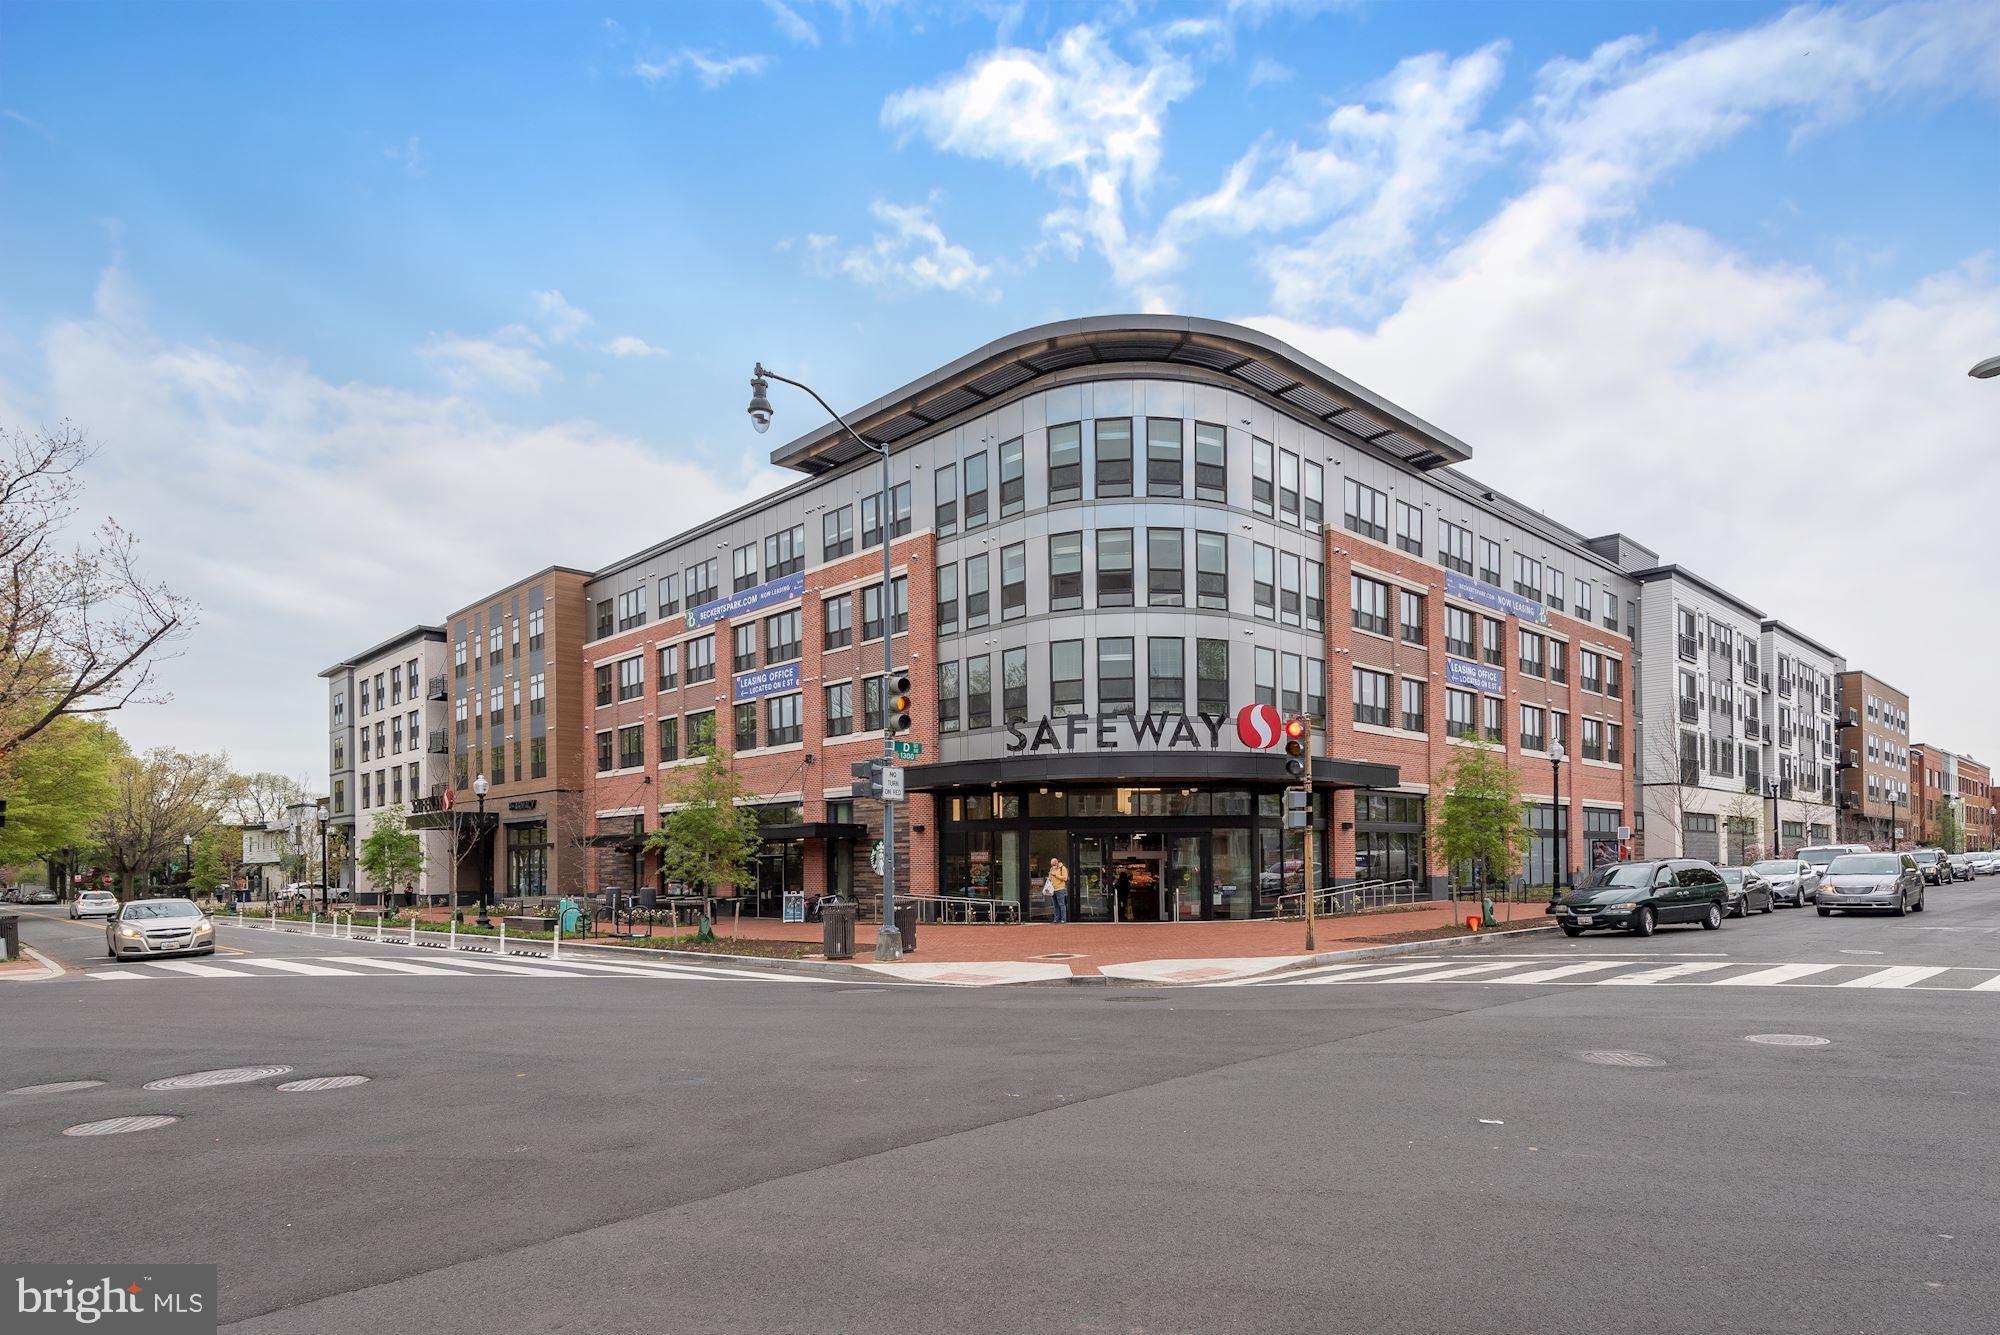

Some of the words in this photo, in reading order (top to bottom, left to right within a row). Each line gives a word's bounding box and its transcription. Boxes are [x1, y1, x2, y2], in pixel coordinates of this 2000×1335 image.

[700, 595, 758, 620] BECKERTSPARK.COM
[760, 591, 772, 600] NOW
[1497, 596, 1511, 608] NOW
[1512, 601, 1535, 616] LEASING
[740, 674, 767, 688] LEASING
[769, 668, 793, 681] OFFICE
[1451, 662, 1476, 677] LEASING
[1477, 669, 1497, 681] OFFICE
[749, 683, 772, 694] LOCATED
[773, 682, 781, 690] ON
[1460, 676, 1480, 687] LOCATED
[1006, 710, 1230, 751] SAFEWAY
[900, 752, 915, 760] 1300
[903, 743, 910, 752] D
